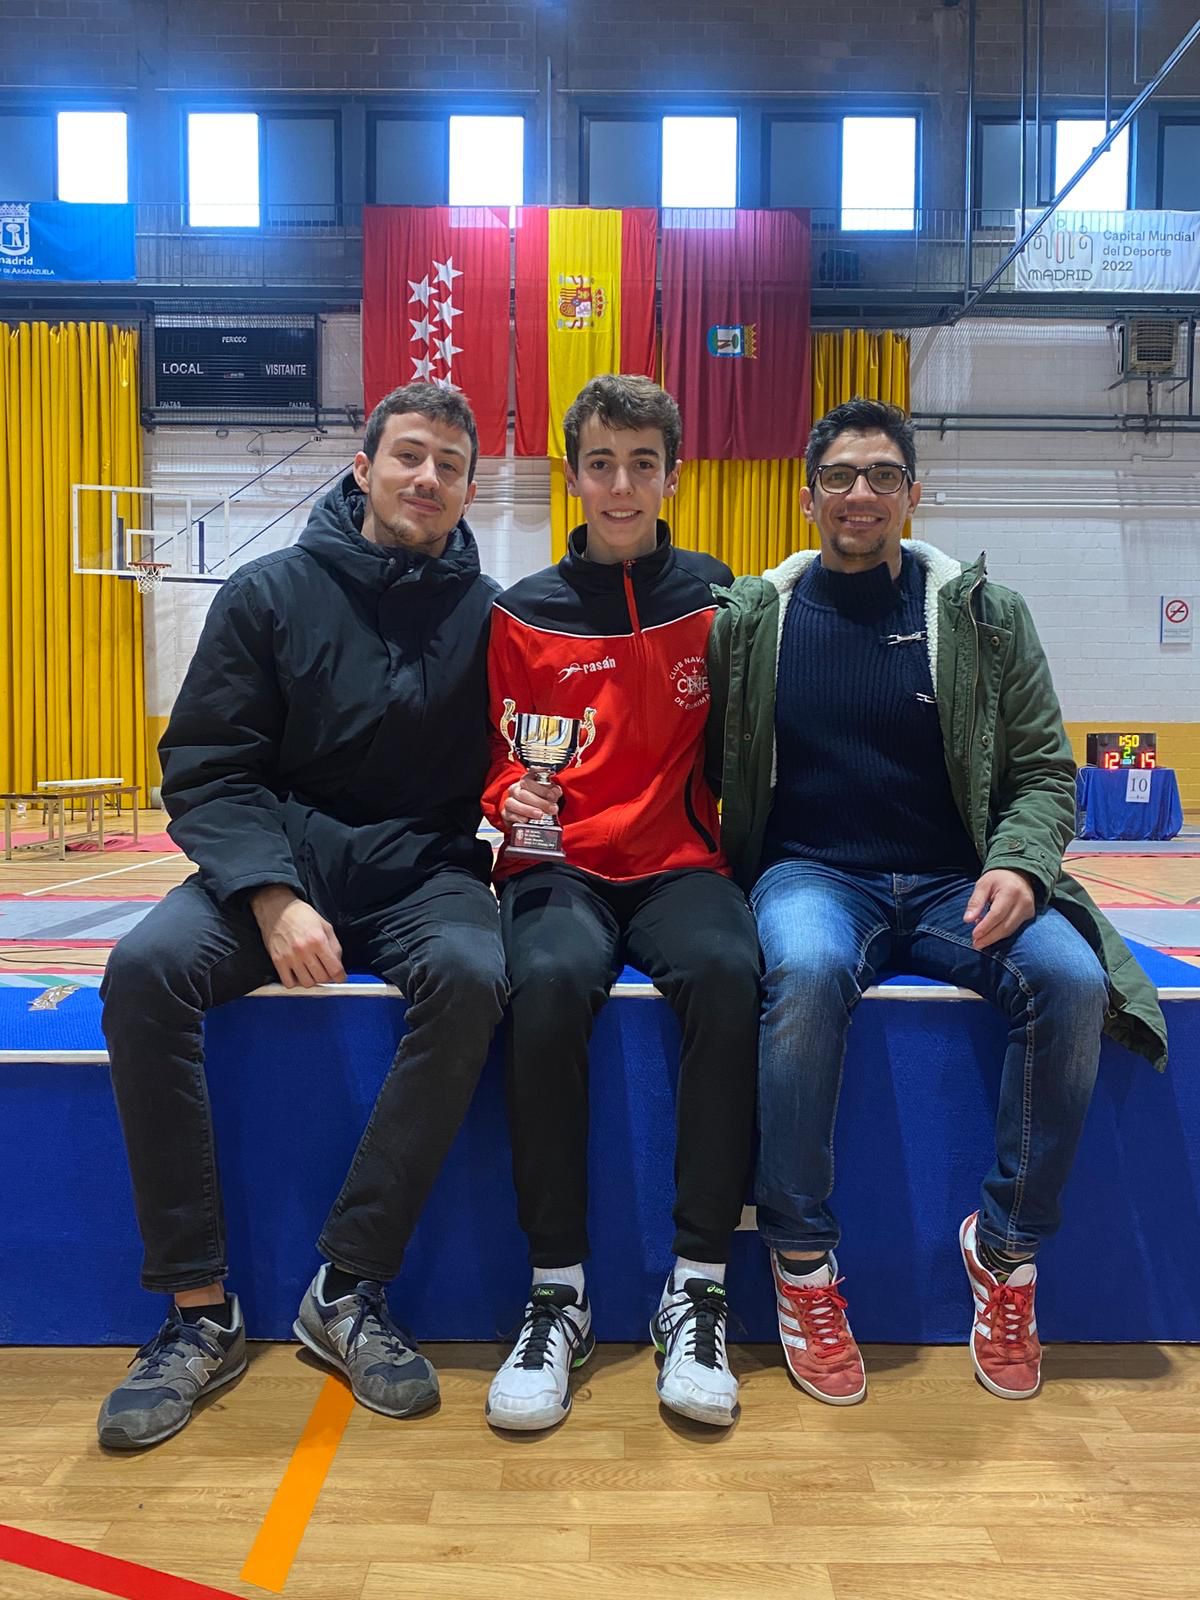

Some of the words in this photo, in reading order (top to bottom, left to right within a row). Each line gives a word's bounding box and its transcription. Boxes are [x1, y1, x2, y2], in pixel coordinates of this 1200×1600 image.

[1103, 230, 1145, 243] Capital
[1149, 230, 1195, 242] Mundial
[1103, 246, 1120, 256] del
[1123, 246, 1172, 258] Deporte
[1102, 261, 1133, 271] 2022
[1028, 269, 1093, 281] MADRID
[162, 363, 204, 375] LOCAL
[265, 364, 307, 376] VISITANTE
[583, 656, 616, 674] rasán
[669, 661, 684, 680] CLUB
[674, 696, 685, 706] DE
[1104, 752, 1120, 769] 12
[1141, 752, 1155, 769] 15
[1130, 778, 1148, 793] 10
